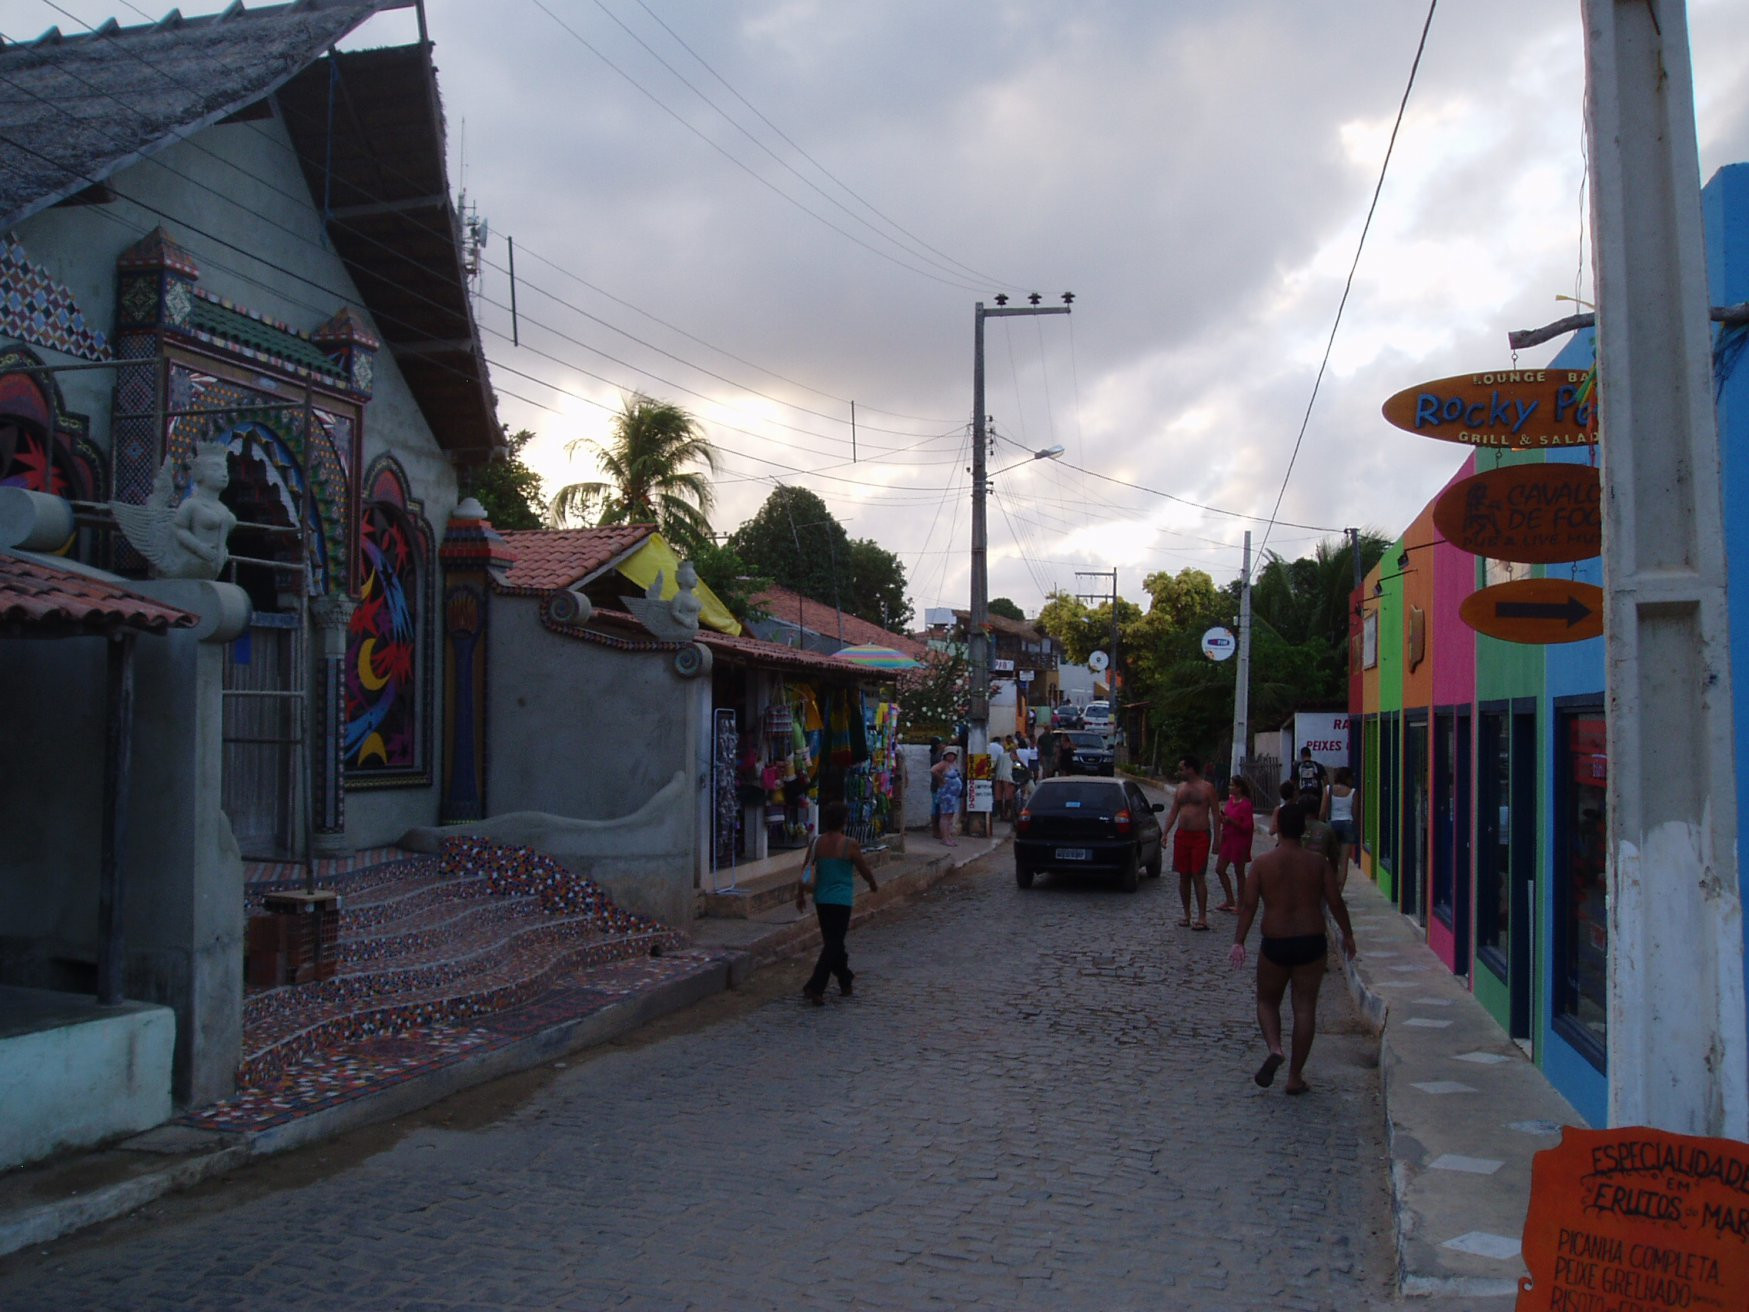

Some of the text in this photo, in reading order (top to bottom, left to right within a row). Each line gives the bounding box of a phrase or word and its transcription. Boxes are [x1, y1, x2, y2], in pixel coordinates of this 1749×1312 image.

[1472, 371, 1546, 385] LOUNGE
[1458, 431, 1509, 446] GRILL
[1520, 433, 1532, 446] &
[1508, 507, 1542, 530] DE
[1306, 740, 1342, 752] PEIXES
[1666, 1177, 1691, 1193] EM
[1558, 1228, 1624, 1266] PICANHA
[1554, 1255, 1692, 1309] PEIXE GRELHADO
